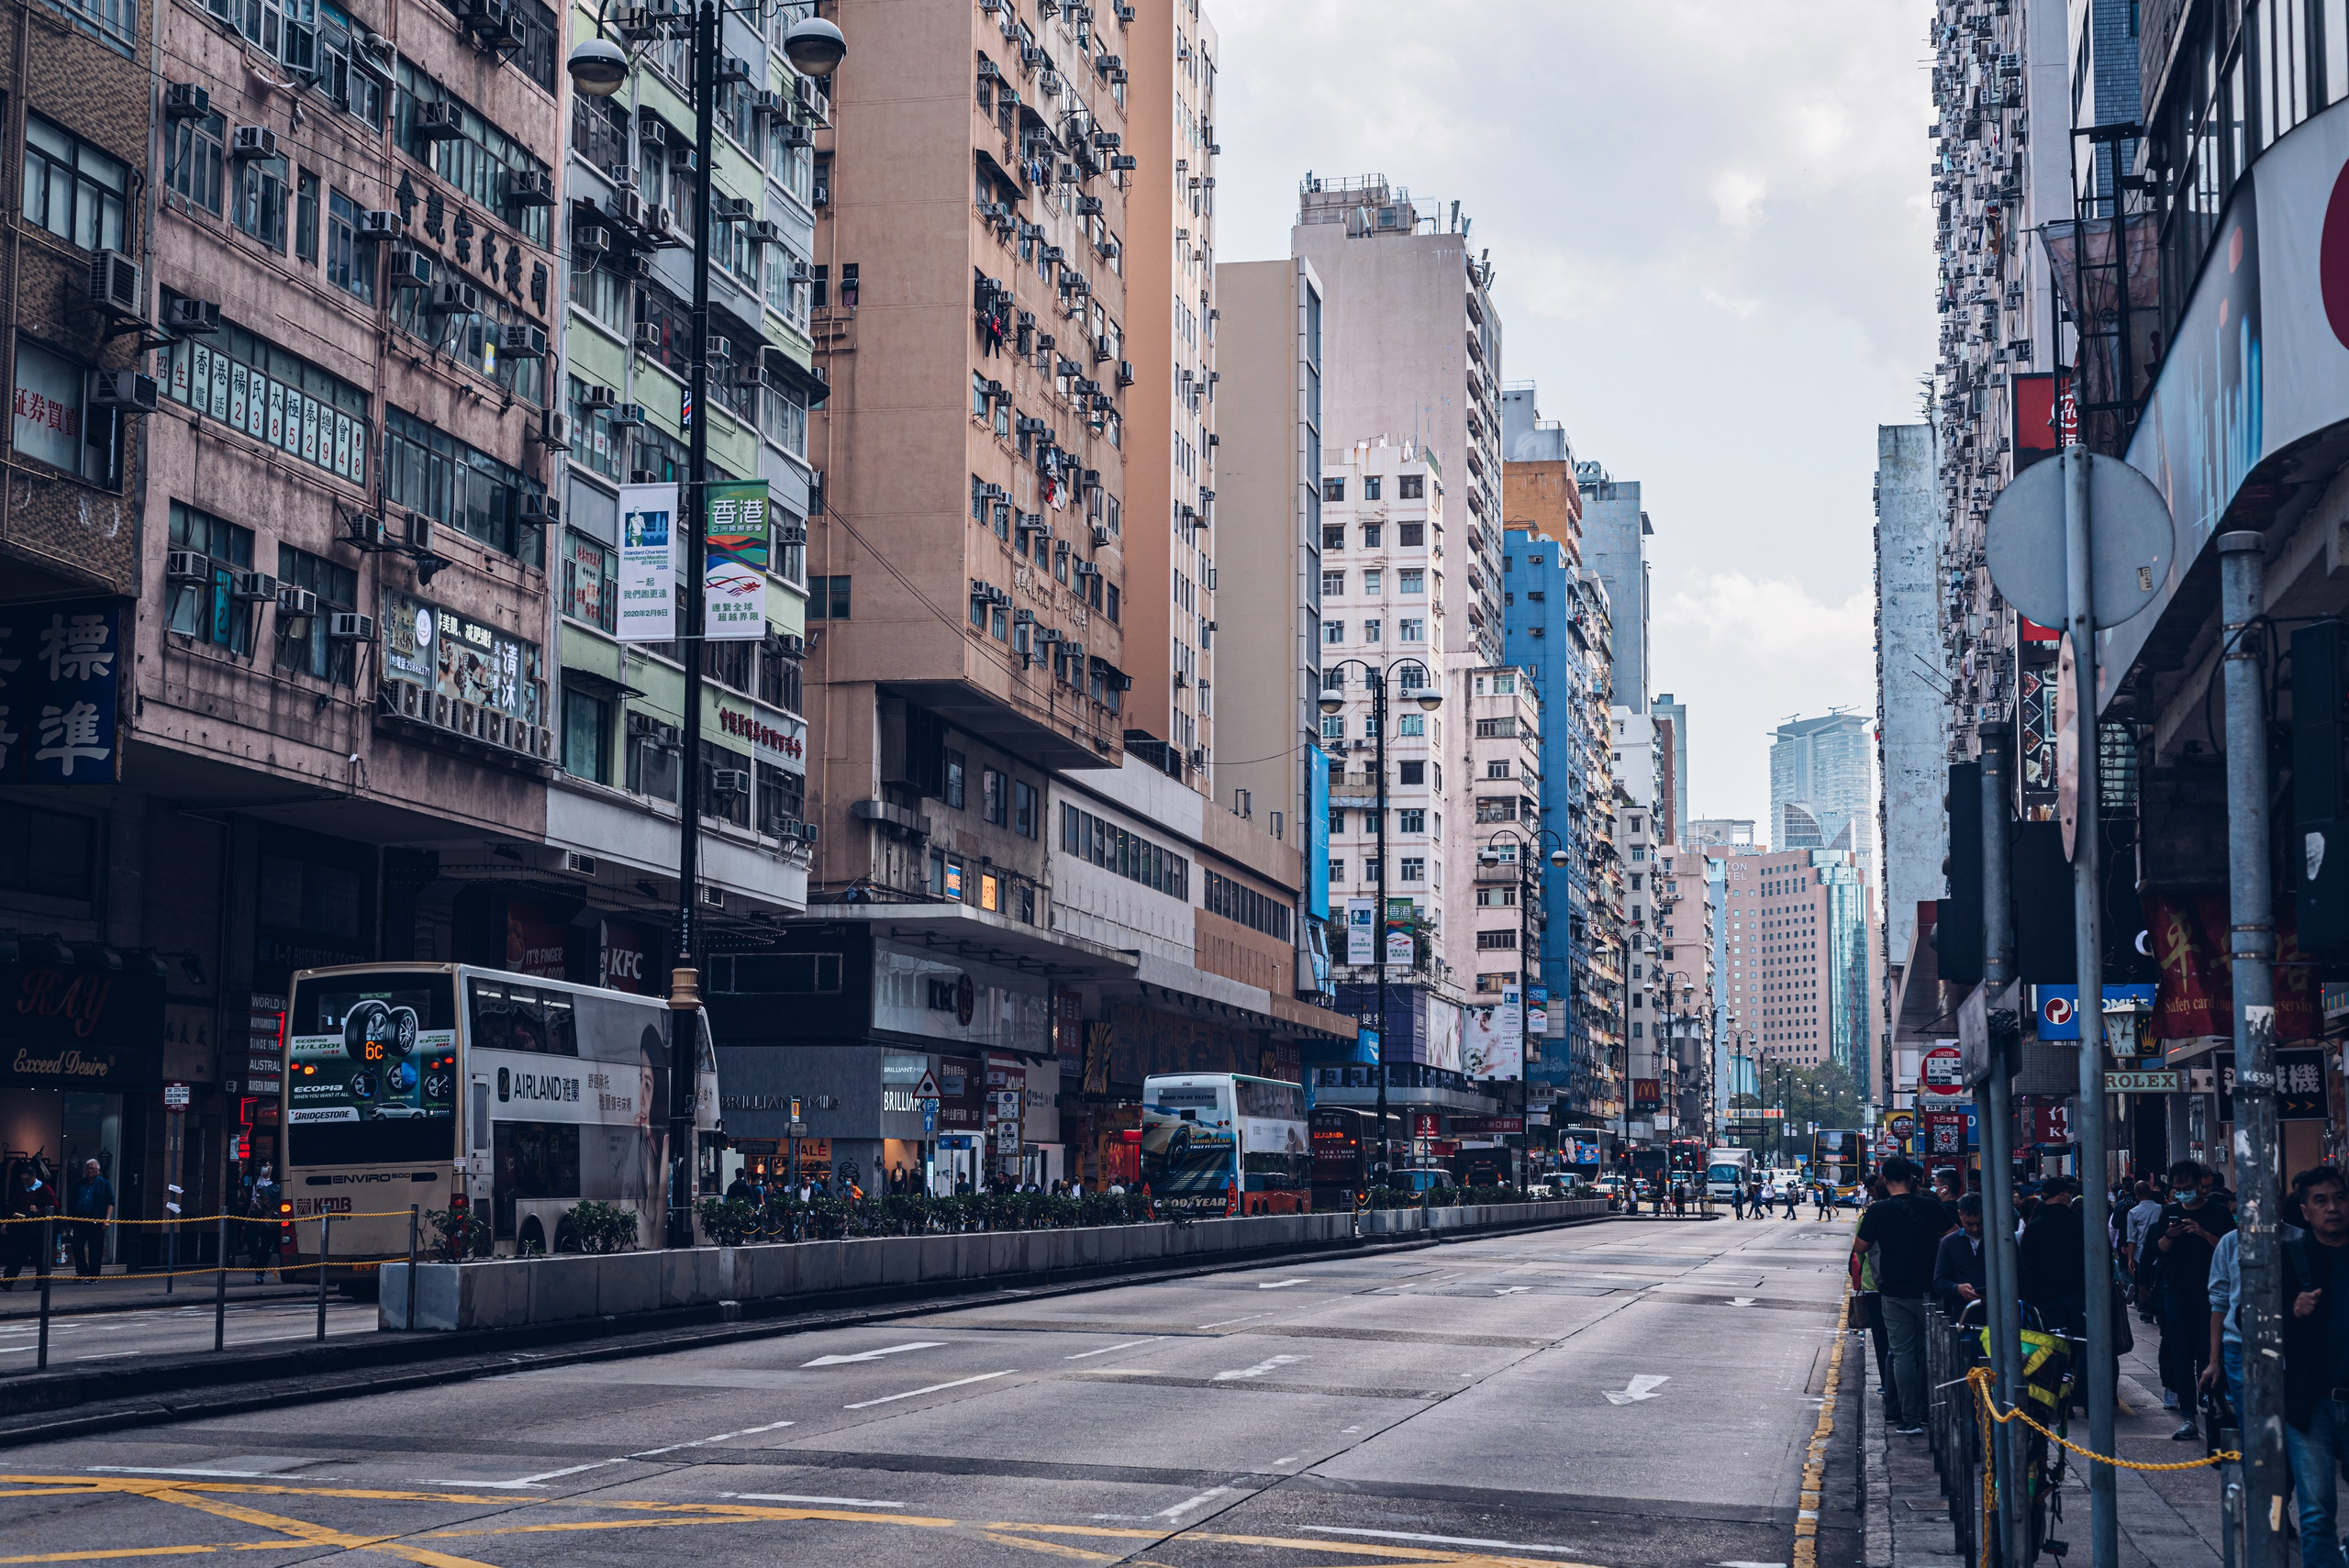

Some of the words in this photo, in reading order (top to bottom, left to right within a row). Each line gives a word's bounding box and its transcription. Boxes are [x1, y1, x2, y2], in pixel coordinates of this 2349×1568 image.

[195, 350, 350, 443] 香港楊氏太極拳總會
[195, 385, 225, 415] 電話
[234, 401, 362, 475] 23852948
[712, 499, 763, 524] 香港
[711, 525, 763, 533] 亞洲國際都會
[636, 577, 654, 586] 一起
[623, 588, 667, 599] 我們跑更遠
[623, 609, 668, 617] 2020年2月9日
[712, 602, 753, 612] 連繫全球
[718, 612, 759, 622] 超越界限
[35, 613, 115, 776] 標準
[1388, 905, 1411, 917] 香港
[294, 946, 333, 967] BUSINESS
[526, 948, 539, 964] IT'S
[540, 947, 562, 962] FINGER
[610, 948, 643, 980] KFC
[251, 995, 280, 1008] WORLD
[928, 978, 956, 1012] ICBC
[2165, 998, 2191, 1016] Safety
[2193, 995, 2214, 1009] card
[2281, 998, 2313, 1014] service
[250, 1039, 266, 1050] SINCE
[13, 1048, 65, 1074] Exceed
[65, 1050, 109, 1077] Desire
[265, 1082, 280, 1092] RAMEN
[514, 1073, 562, 1101] AIRLAND
[2105, 1074, 2176, 1088] ROLEX
[562, 1078, 580, 1102] 雅蘭
[294, 1110, 350, 1121] BRIDGESTONE
[1315, 1118, 1341, 1127] 周大福
[1487, 1120, 1519, 1129] 東亞銀行
[793, 1145, 827, 1156] SALE
[314, 1196, 352, 1214] KMB
